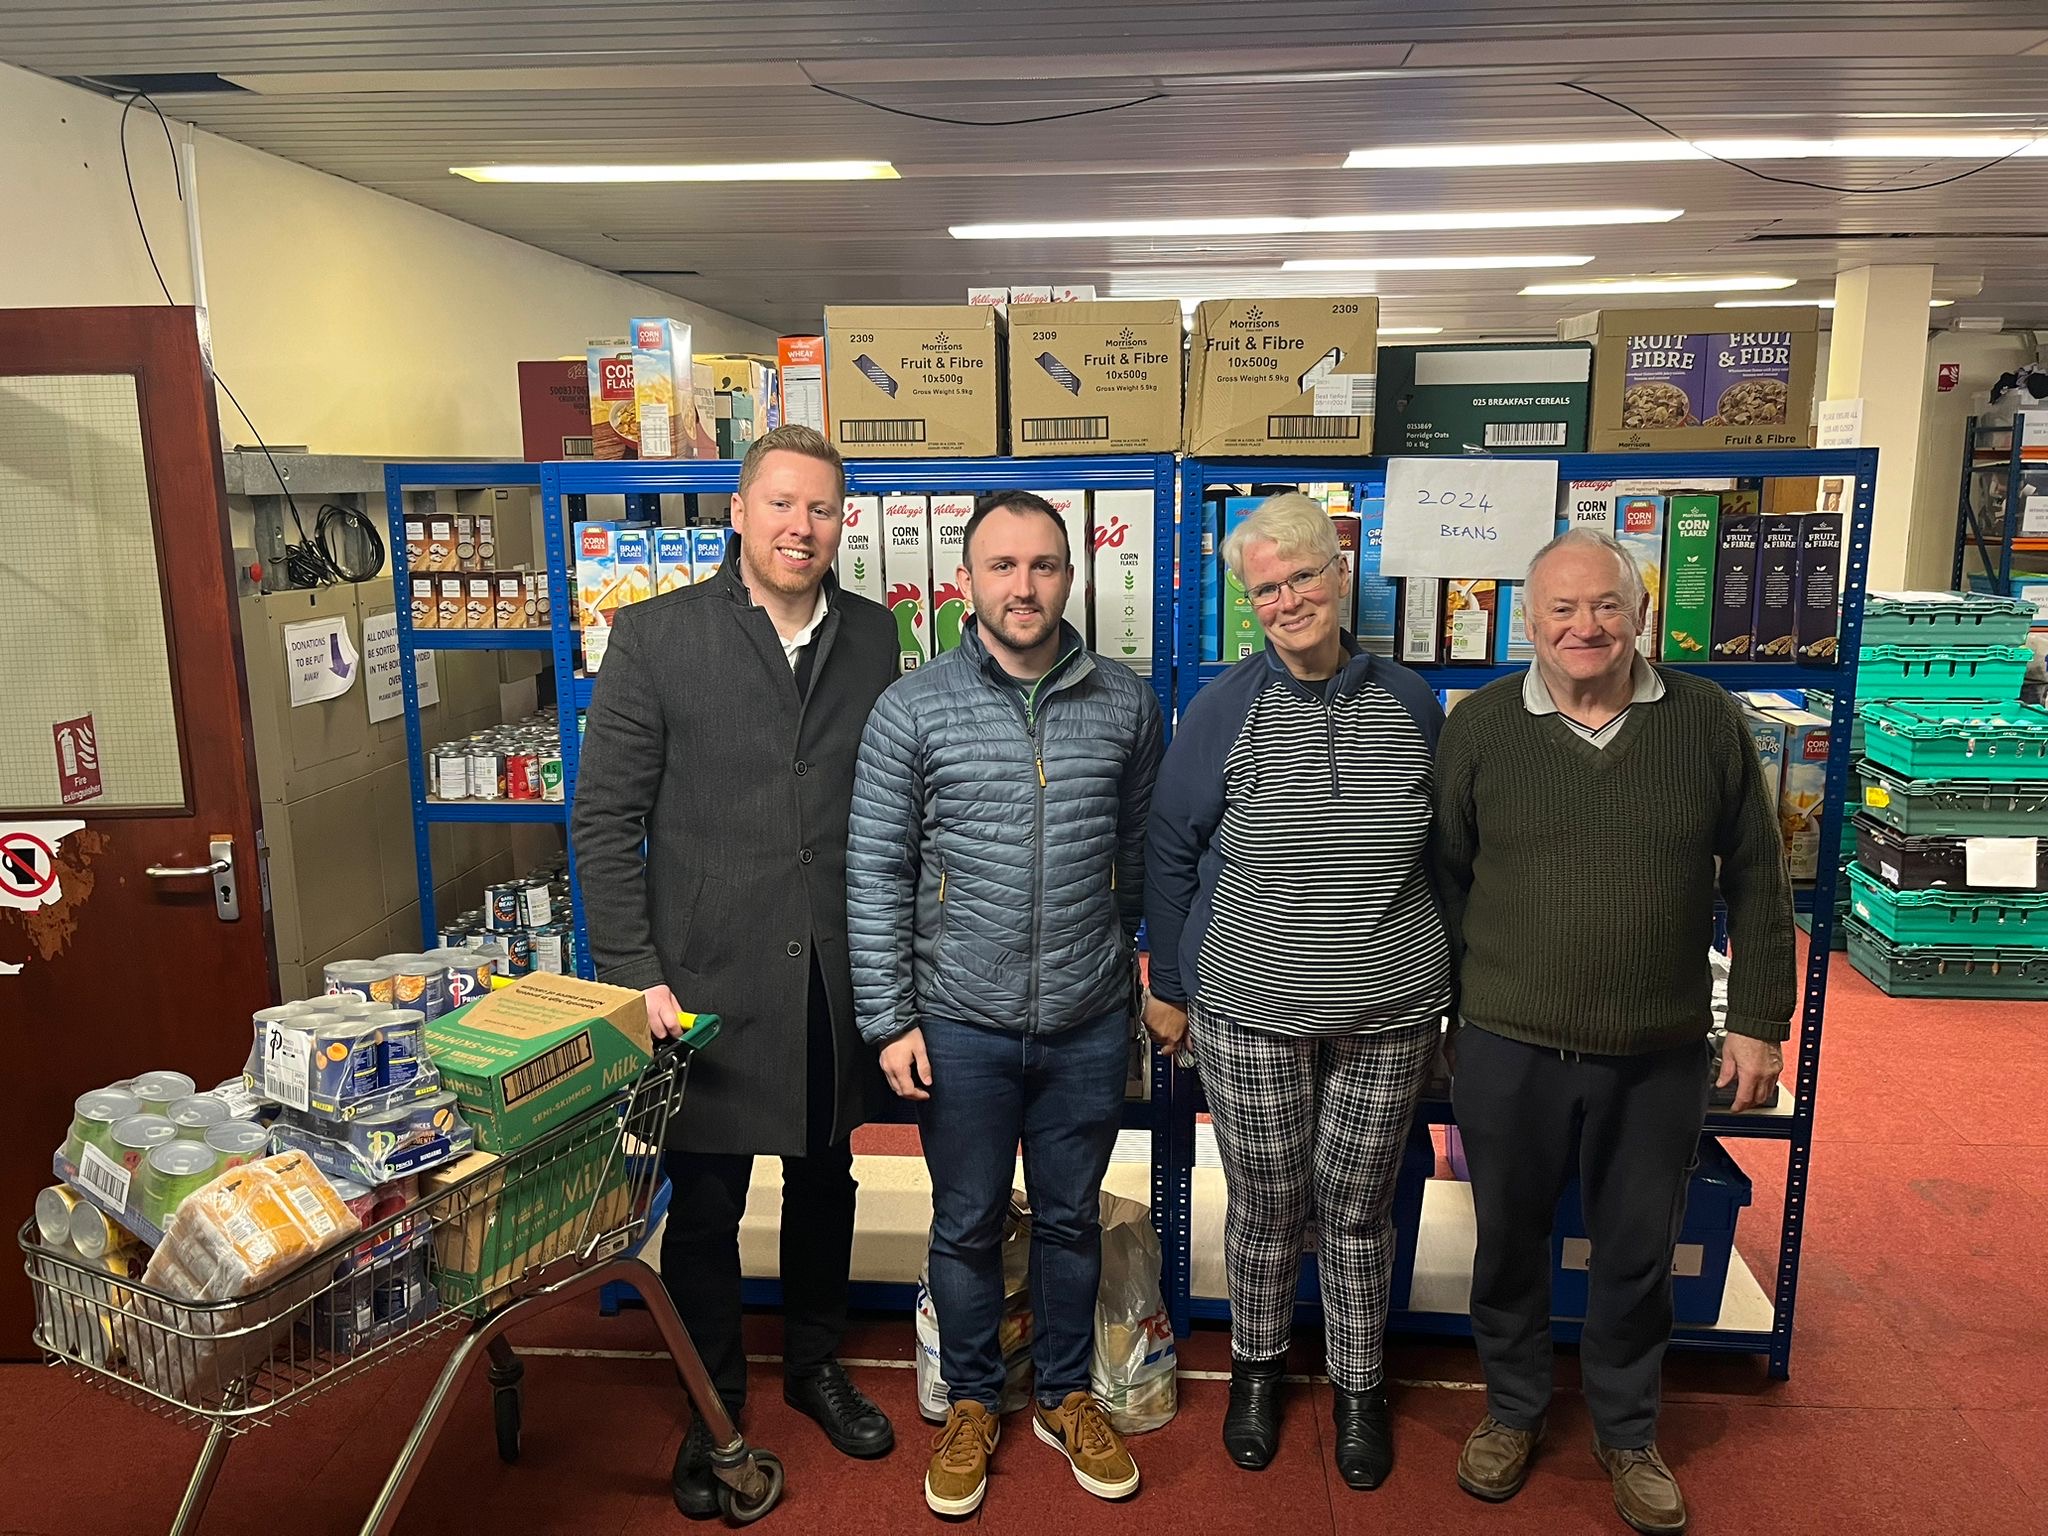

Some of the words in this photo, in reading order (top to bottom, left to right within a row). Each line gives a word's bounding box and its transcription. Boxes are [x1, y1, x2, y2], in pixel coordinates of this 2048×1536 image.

[1332, 304, 1358, 314] 2309
[1230, 320, 1280, 328] Morrisons
[850, 334, 874, 342] 2309
[1032, 332, 1057, 340] 2309
[1206, 337, 1240, 352] Fruit
[1245, 336, 1257, 350] &
[1263, 336, 1305, 350] Fibre
[901, 358, 932, 369] Fruit
[936, 357, 945, 368] &
[950, 357, 984, 368] Fibre
[1084, 354, 1116, 366] Fruit
[1120, 353, 1129, 365] &
[1134, 352, 1169, 364] Fibre
[1228, 357, 1278, 369] 10x500g
[1631, 351, 1696, 370] FIBRE
[1718, 351, 1736, 368] &
[1740, 347, 1789, 365] FIBR
[605, 364, 635, 379] COR
[1106, 370, 1147, 380] 10x500g
[607, 379, 635, 389] FLAK
[922, 374, 963, 384] 10x500g
[1240, 375, 1267, 383] Weight
[1268, 375, 1289, 383] 5.9kg
[1725, 436, 1751, 445] Fruit
[1755, 435, 1763, 444] &
[1767, 435, 1796, 444] Fibre
[1417, 489, 1494, 514] 2024
[1577, 501, 1607, 512] CORN
[886, 504, 924, 518] Kellogg's
[933, 503, 972, 517] Kellogg's
[1577, 512, 1606, 521] FLAKES
[1678, 520, 1710, 530] CORN
[892, 527, 919, 537] CORN
[1440, 524, 1497, 541] BEANS
[367, 632, 376, 642] ALL
[378, 628, 397, 640] DONATI
[291, 637, 326, 651] DONATIONS
[368, 649, 375, 658] BE
[375, 644, 396, 657] SORTED
[296, 658, 304, 667] TO
[305, 657, 313, 666] BE
[314, 654, 324, 663] PUT
[370, 666, 376, 674] IN
[377, 662, 388, 672] THE
[304, 672, 319, 682] AWAY
[74, 776, 87, 787] Fire
[63, 784, 101, 803] extinguisher
[602, 1053, 640, 1090] Milk
[531, 1084, 593, 1125] SEMI-SKIMMED
